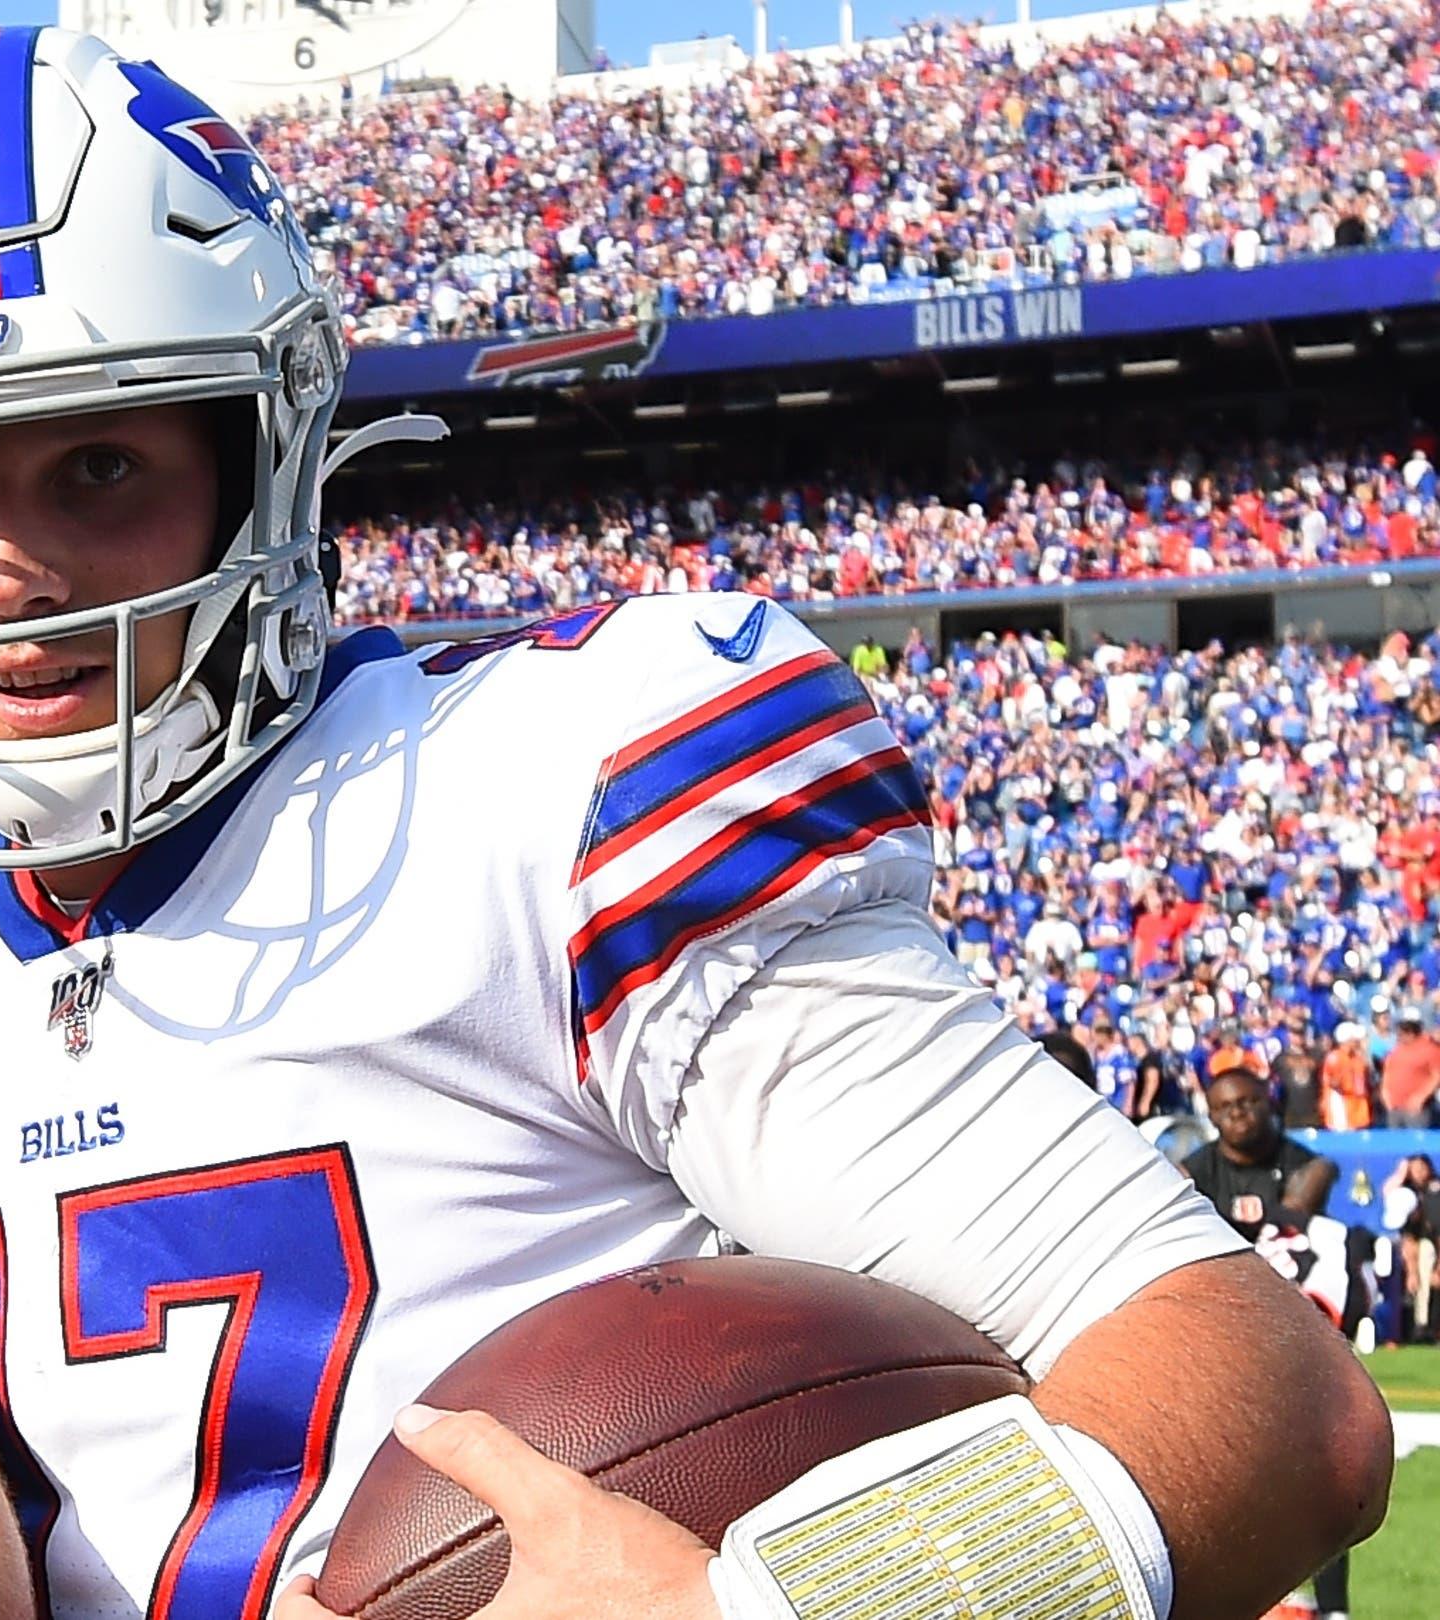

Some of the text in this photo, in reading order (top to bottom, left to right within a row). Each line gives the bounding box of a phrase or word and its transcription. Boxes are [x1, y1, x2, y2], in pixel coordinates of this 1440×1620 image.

[294, 37, 317, 70] 6
[916, 287, 1082, 347] BILLS WIN
[18, 1101, 126, 1164] BILLS
